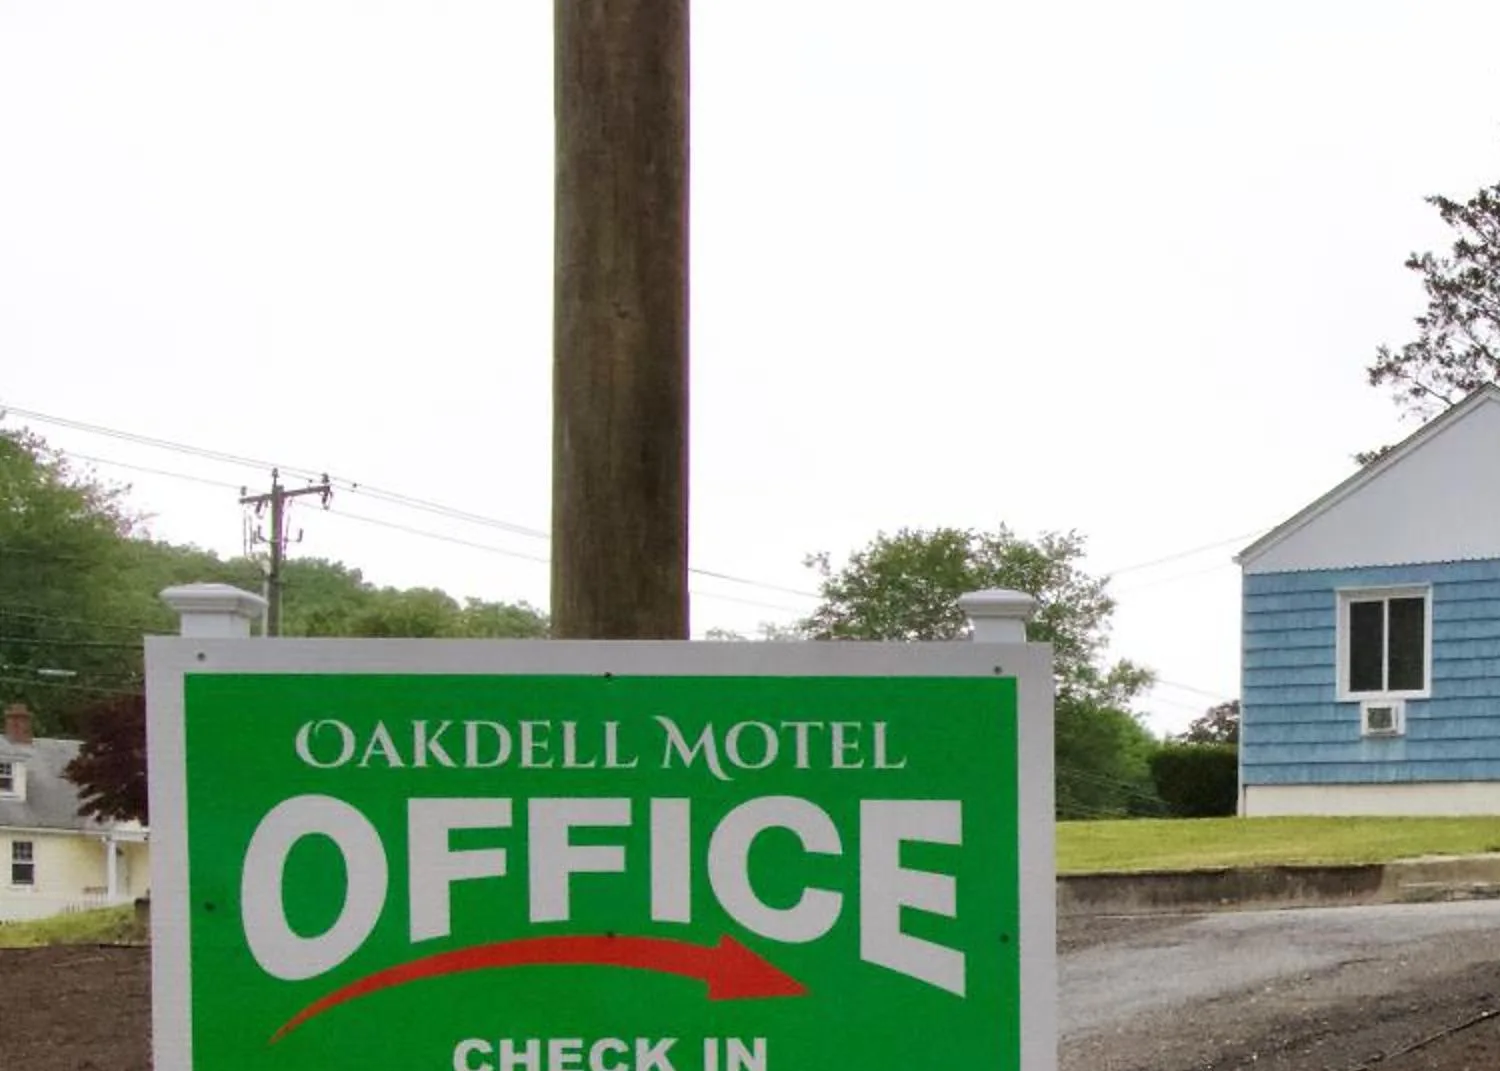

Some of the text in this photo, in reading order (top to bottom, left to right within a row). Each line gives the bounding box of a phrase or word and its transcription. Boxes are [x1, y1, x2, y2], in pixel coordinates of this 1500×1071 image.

[294, 715, 908, 781] OAKDELL MOTEL
[240, 793, 966, 998] OFFICE
